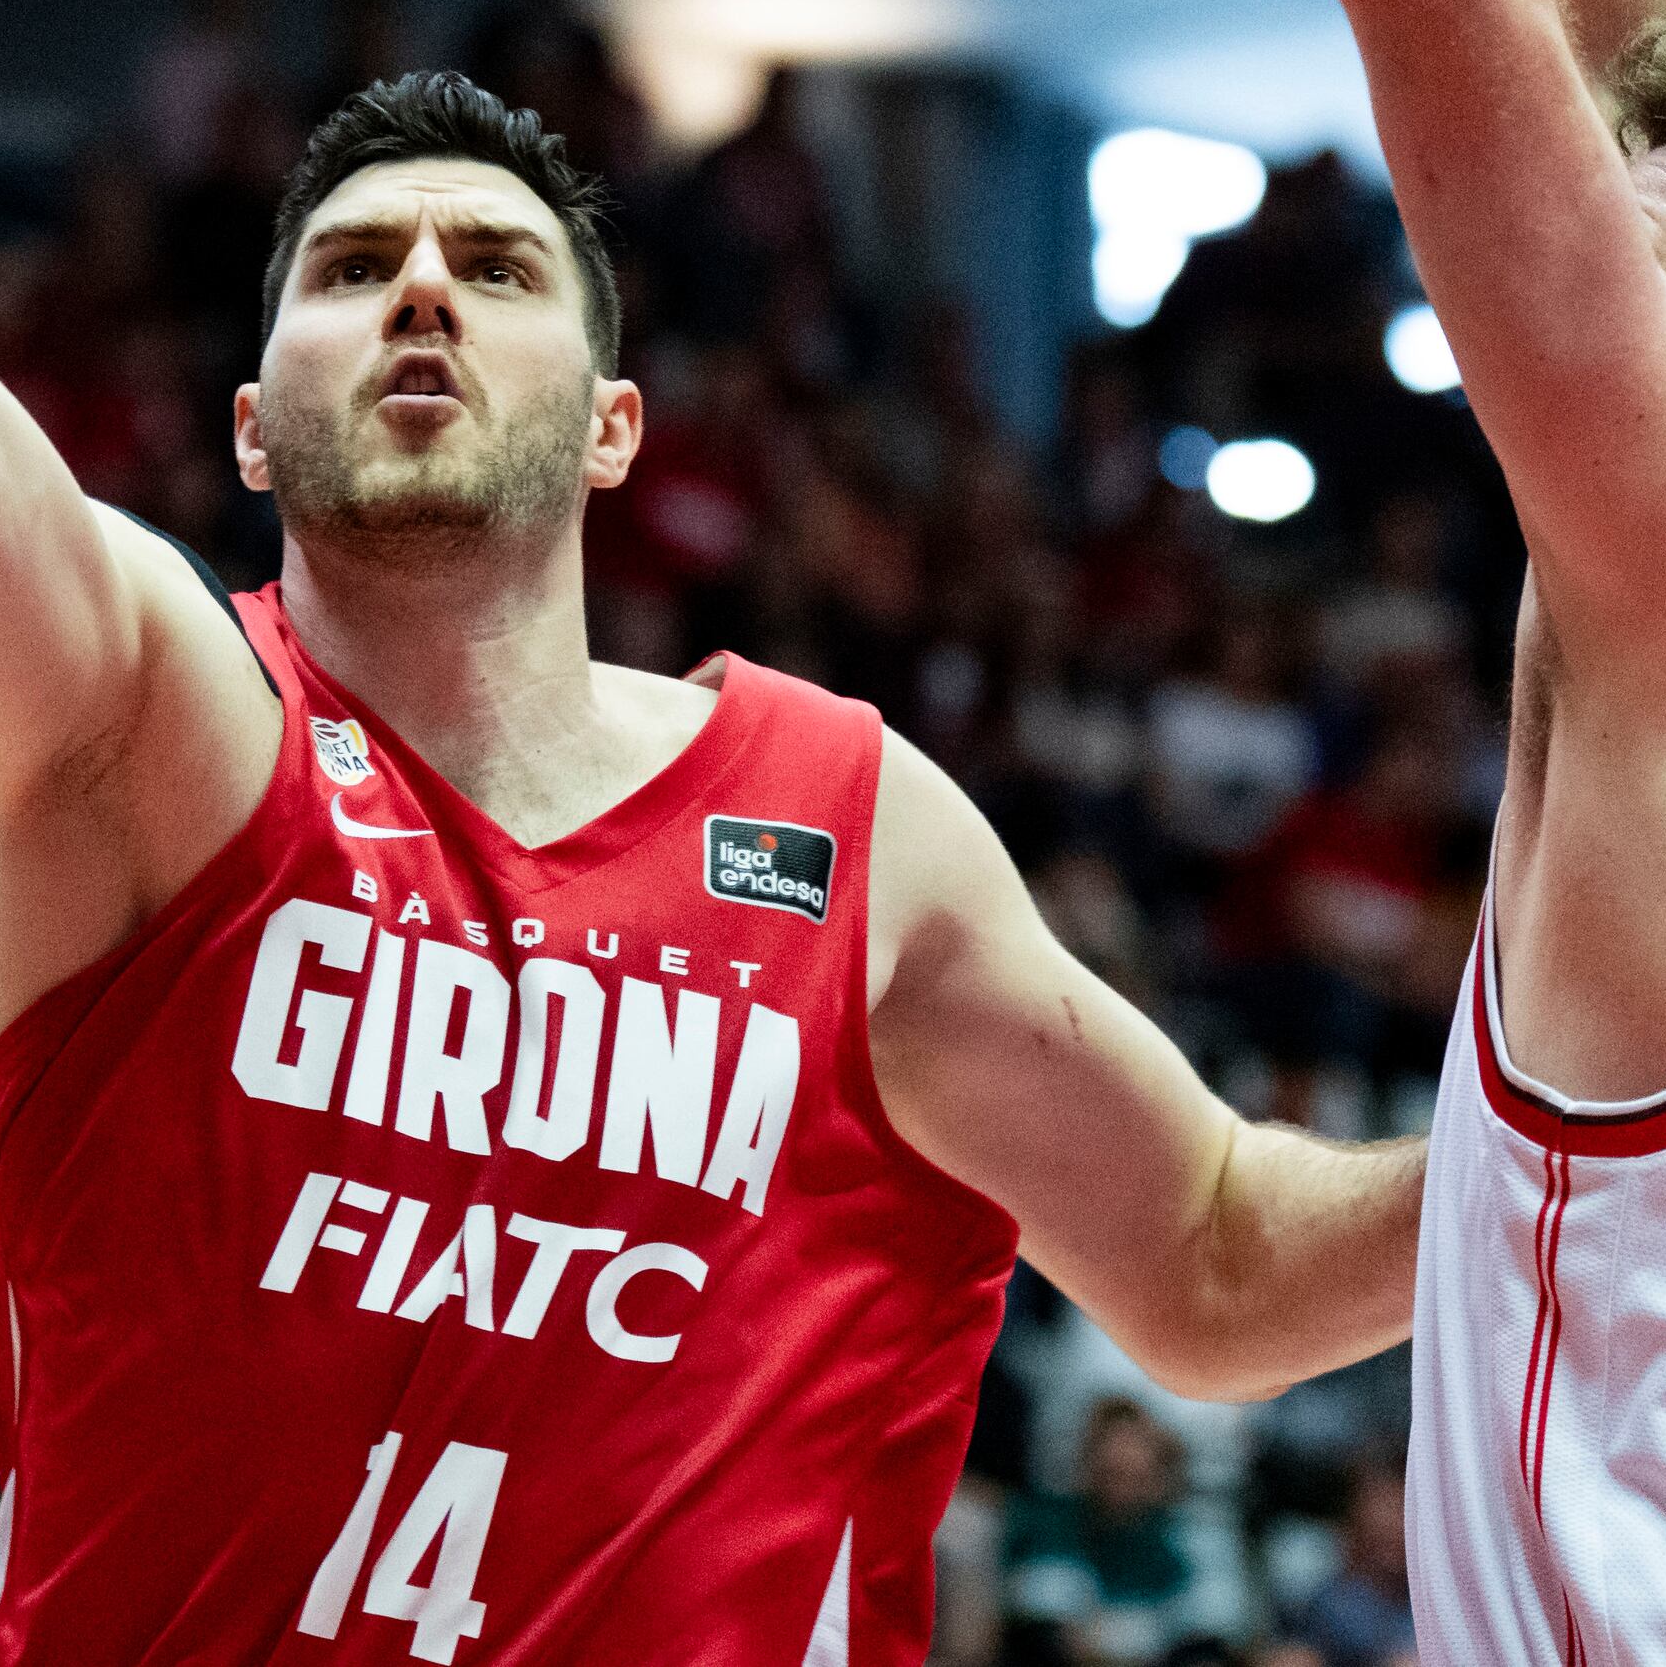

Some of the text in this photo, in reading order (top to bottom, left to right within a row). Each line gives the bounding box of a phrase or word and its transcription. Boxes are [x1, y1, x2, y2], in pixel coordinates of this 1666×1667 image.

[351, 869, 762, 989] BÀSQUET
[719, 841, 772, 870] liga
[719, 869, 825, 910] endesa
[230, 897, 801, 1218] GIRONA
[258, 1171, 710, 1364] FIATC
[296, 1429, 509, 1666] 14
